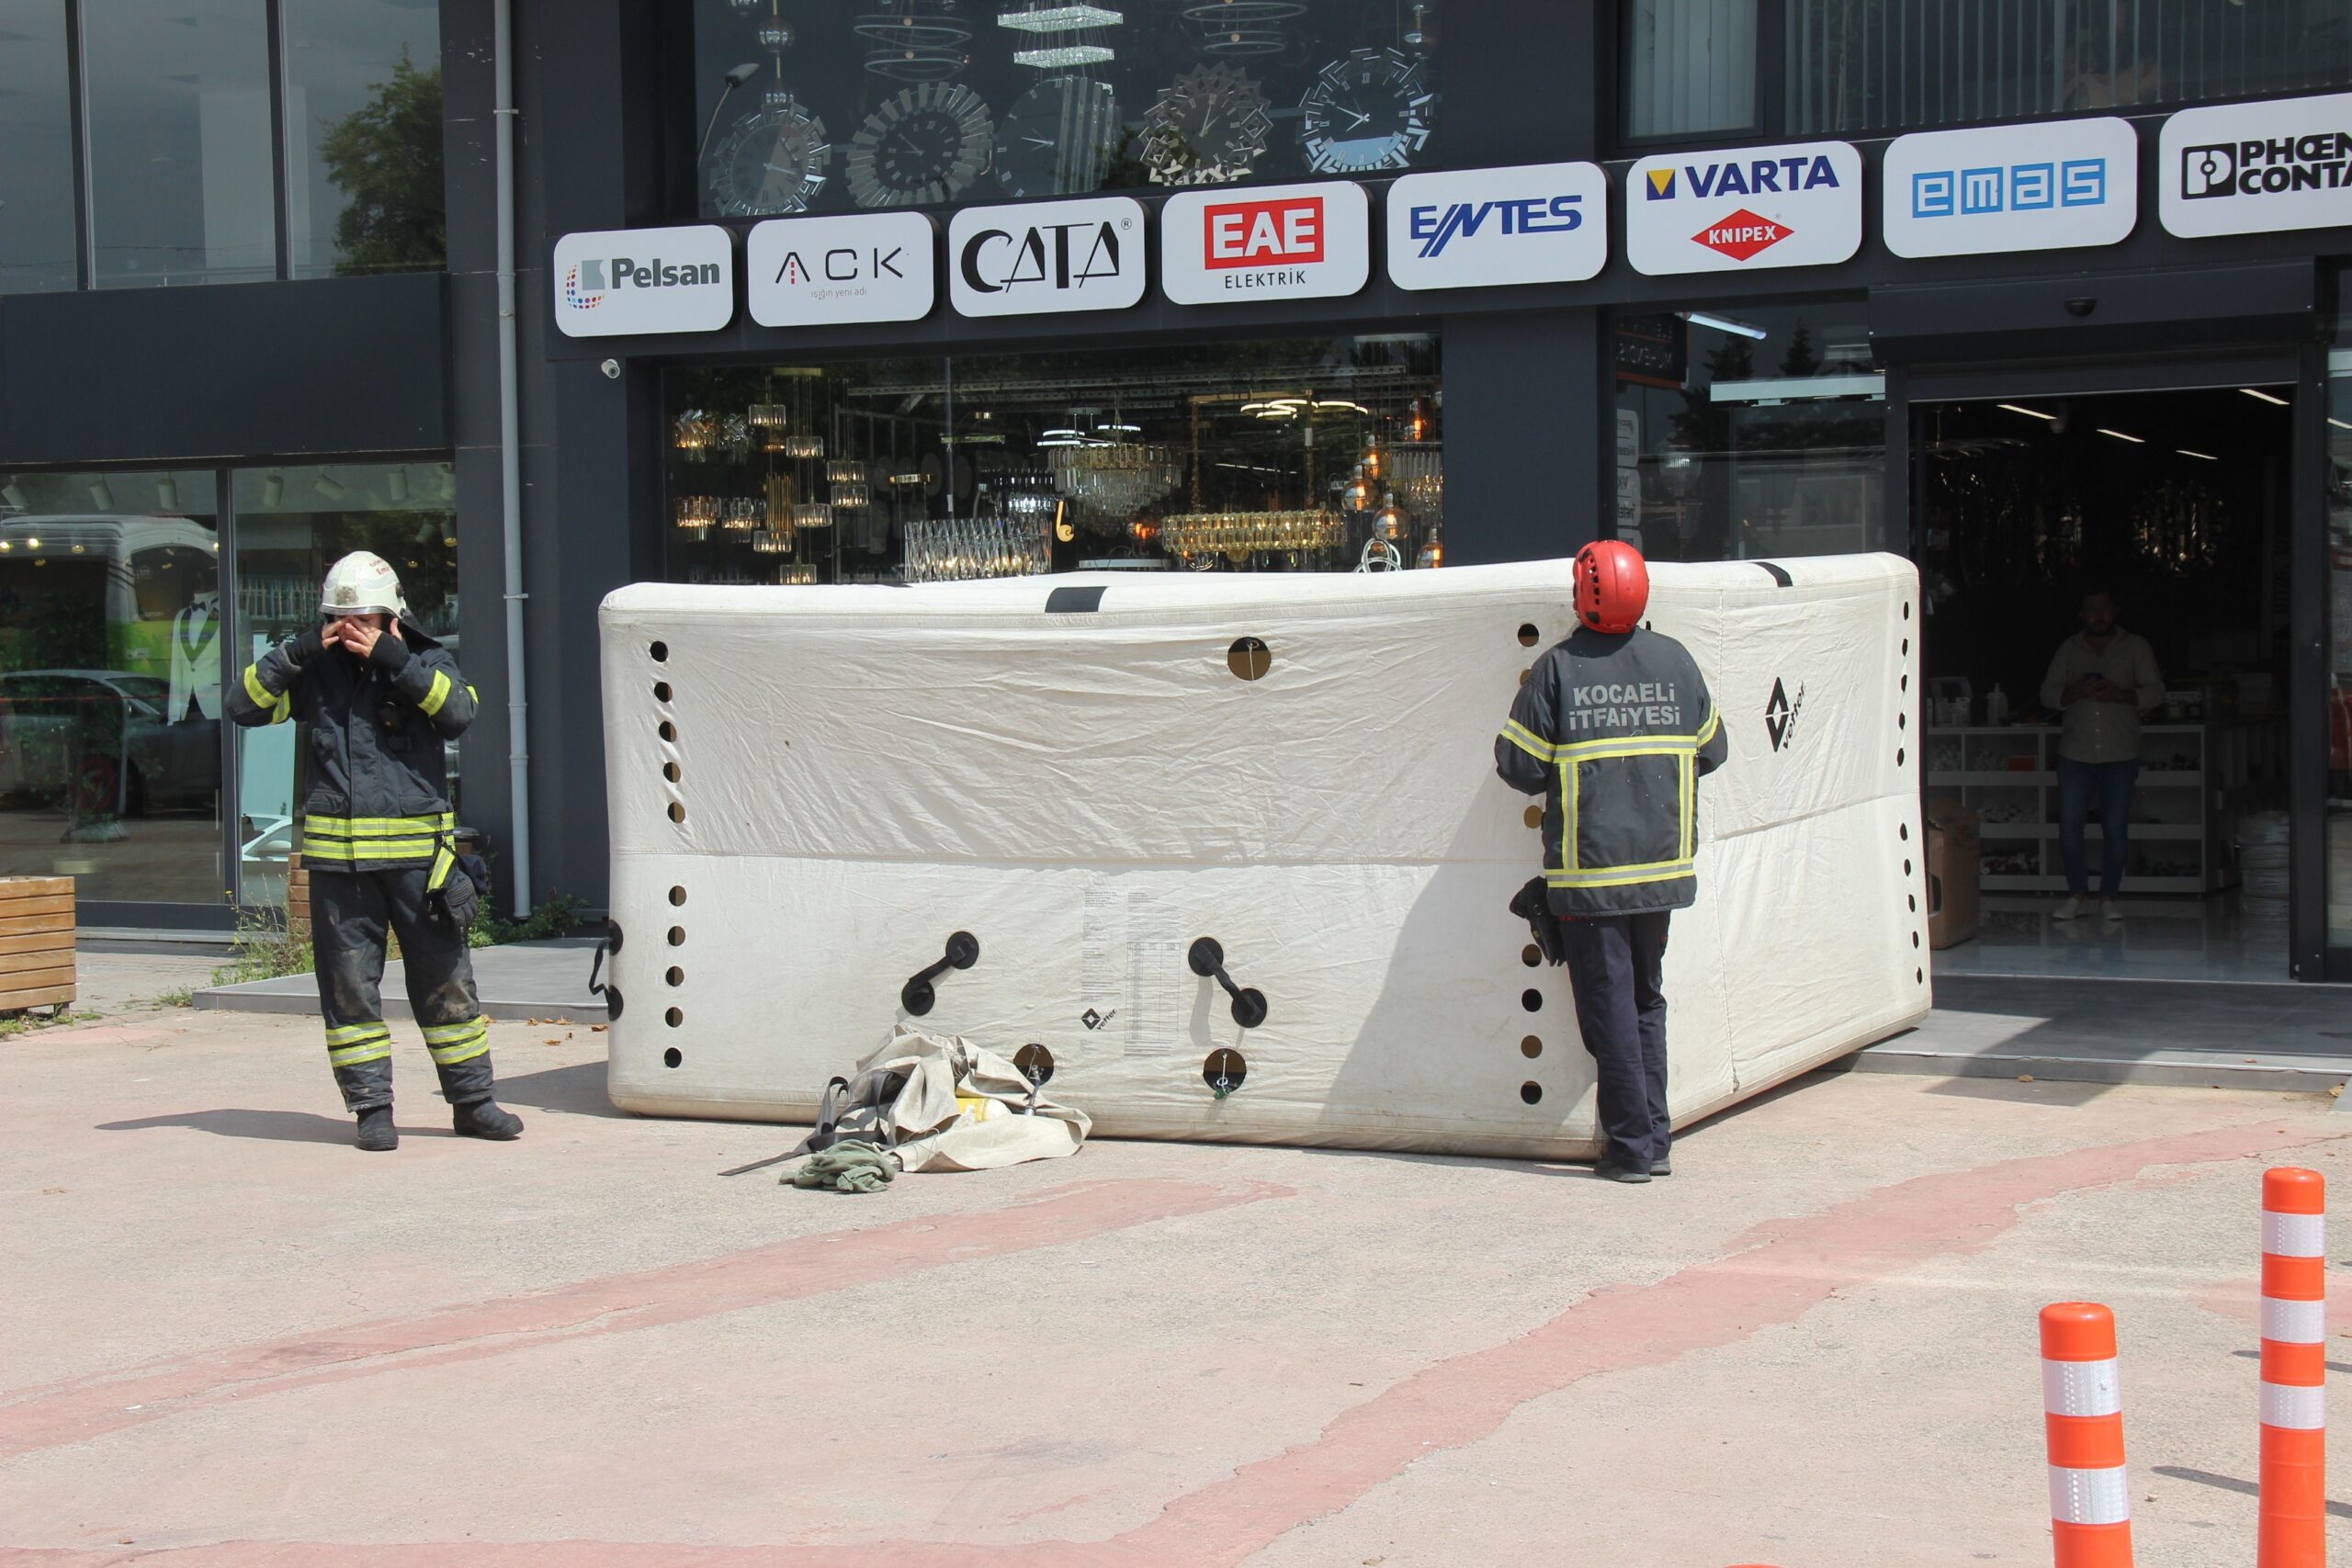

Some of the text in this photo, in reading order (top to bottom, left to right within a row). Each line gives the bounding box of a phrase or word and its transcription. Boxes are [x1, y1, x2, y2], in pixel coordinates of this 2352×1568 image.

[1684, 155, 1840, 198] VARTA
[1914, 160, 2103, 217] emas
[1213, 208, 1316, 258] EAE
[1410, 195, 1582, 258] ENTES
[1709, 226, 1778, 244] KNIPEX
[611, 257, 720, 289] Pelsan
[775, 246, 903, 284] ACK
[960, 221, 1120, 293] CATA
[835, 288, 853, 299] yeni
[1096, 1009, 1117, 1031] vetter
